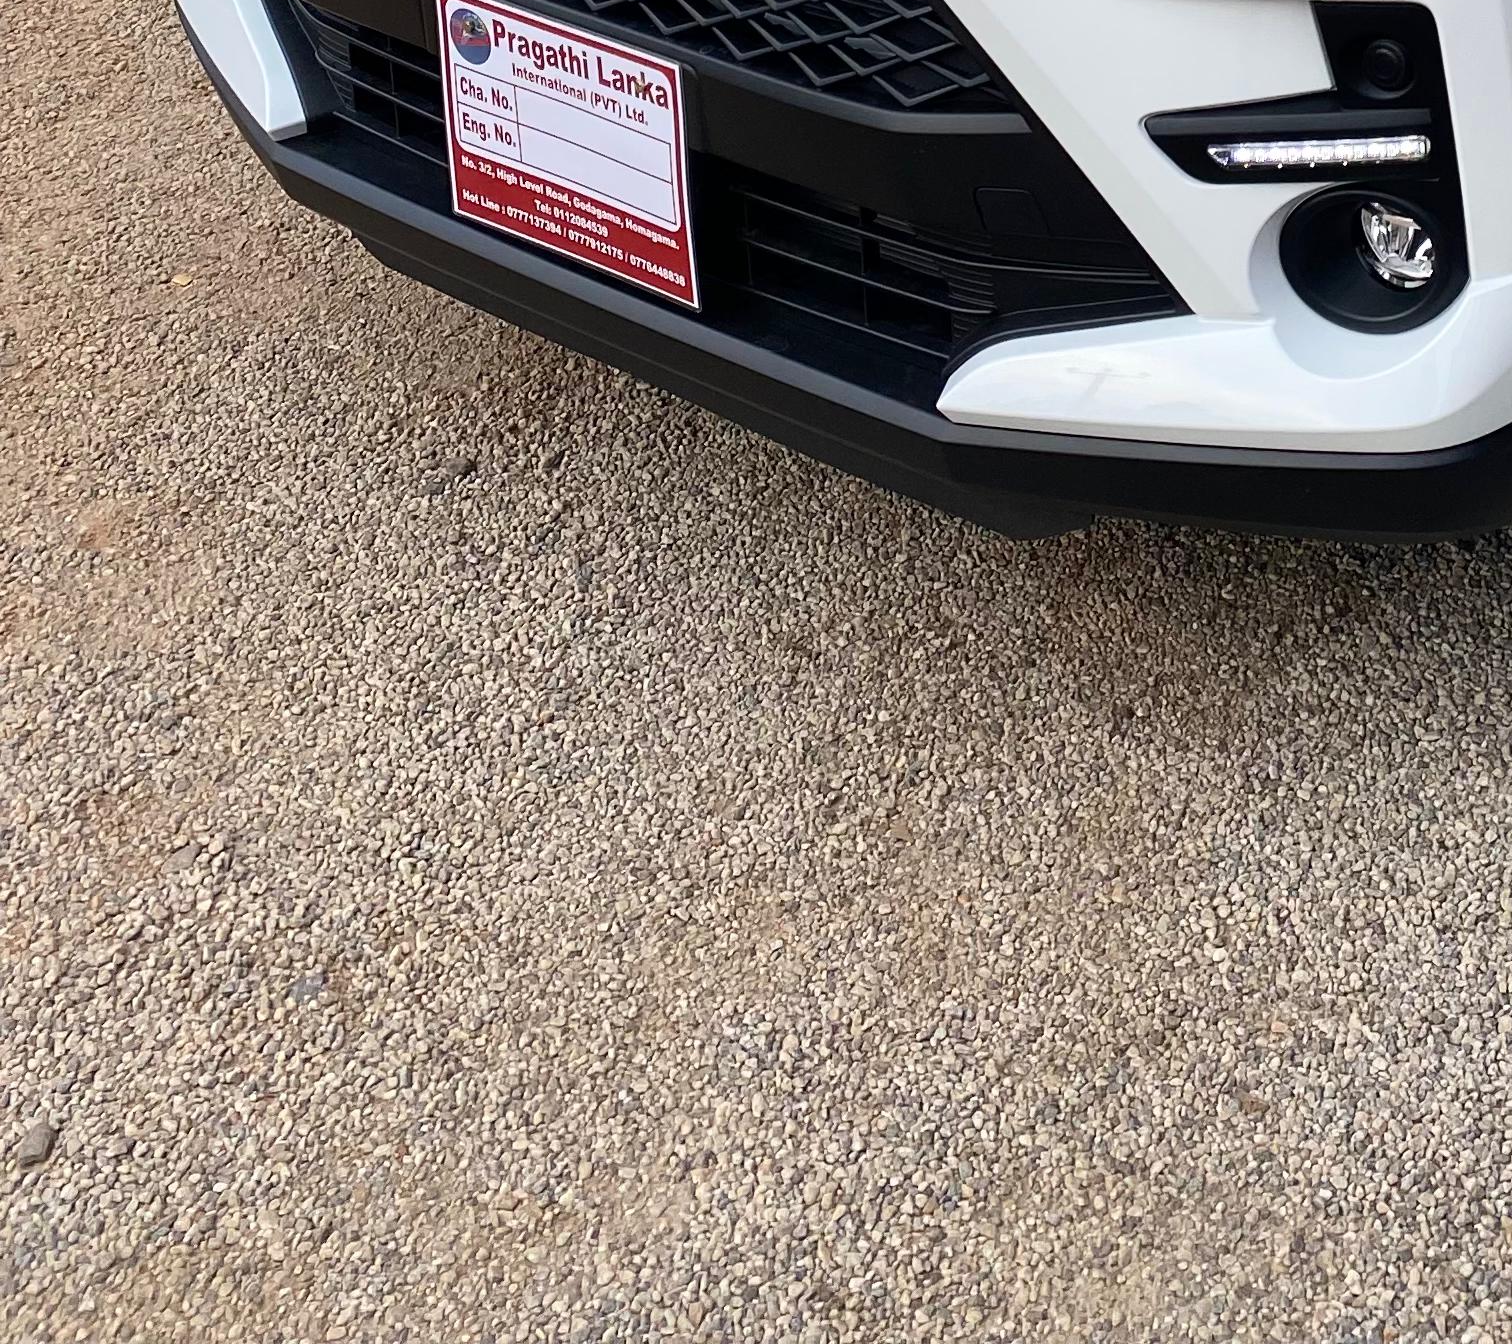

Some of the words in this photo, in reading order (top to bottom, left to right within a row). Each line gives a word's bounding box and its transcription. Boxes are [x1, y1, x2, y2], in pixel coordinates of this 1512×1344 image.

[491, 18, 589, 80] Pragathi
[596, 56, 669, 110] Lanka
[460, 76, 488, 103] Cha.
[491, 87, 513, 112] No.
[512, 62, 587, 102] International
[590, 90, 622, 119] (PVT)
[625, 104, 648, 127] Ltd.
[462, 112, 491, 142] Eng.
[493, 123, 517, 148] No.
[462, 188, 480, 205] Hot
[480, 195, 501, 213] Line
[496, 168, 518, 186] High
[519, 175, 544, 195] Level
[545, 185, 572, 208] Road,
[534, 199, 552, 216] Tel:
